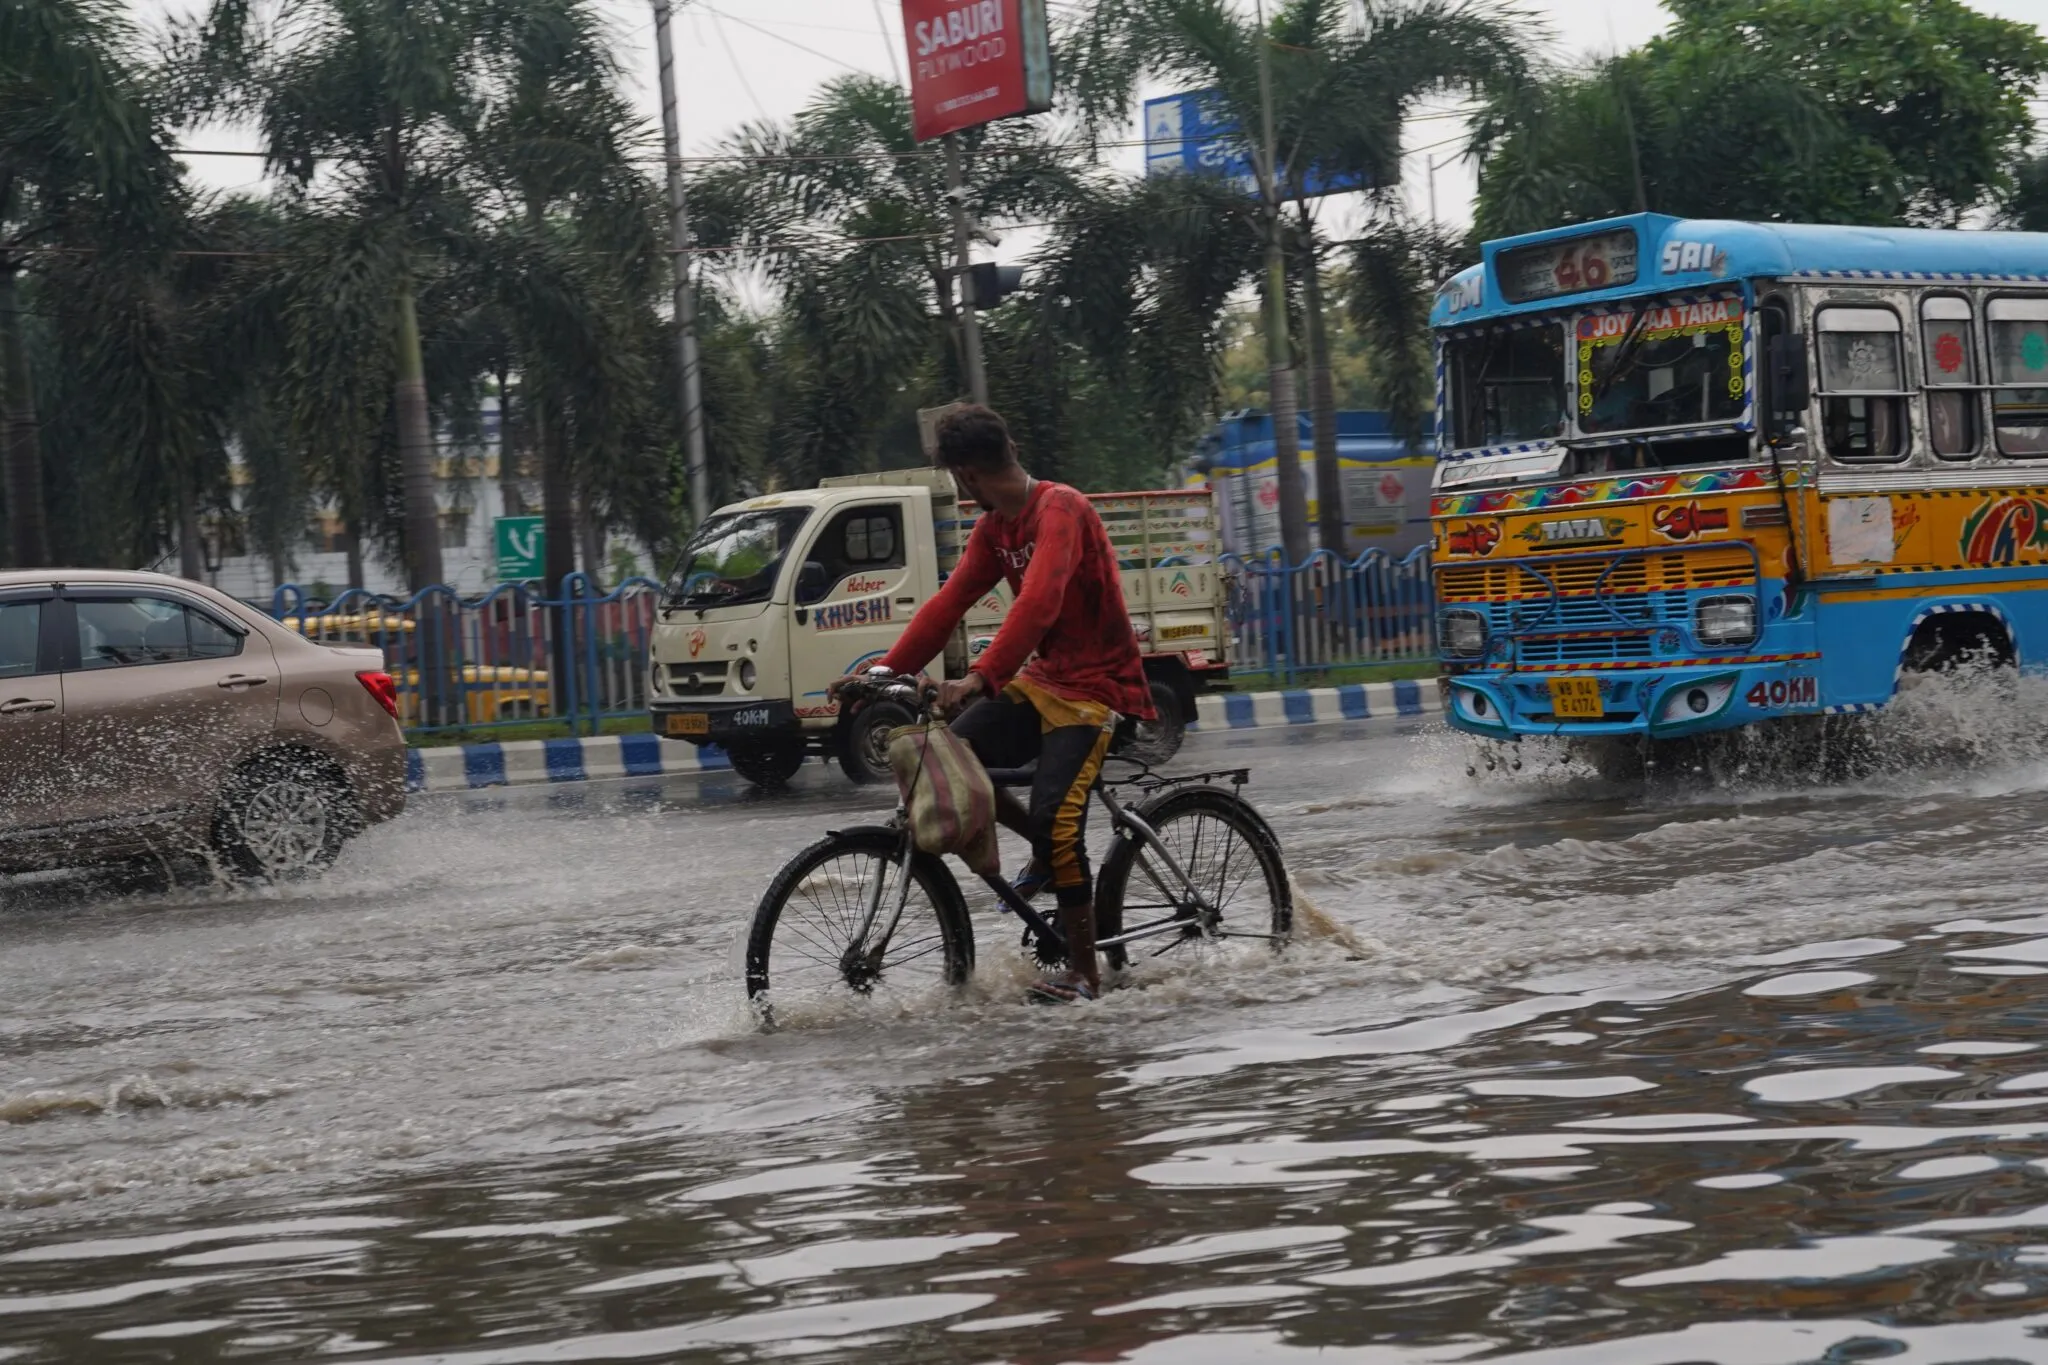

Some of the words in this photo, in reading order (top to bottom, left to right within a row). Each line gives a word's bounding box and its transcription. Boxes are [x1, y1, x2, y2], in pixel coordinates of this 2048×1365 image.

[915, 0, 1004, 55] SABURI
[917, 37, 1007, 81] PLYWOOD
[1553, 243, 1609, 289] 46
[1661, 241, 1716, 276] SAI
[1594, 314, 1629, 337] JOY
[1677, 302, 1728, 324] TARA
[1541, 519, 1604, 540] TATA
[847, 576, 886, 593] Helper
[814, 596, 891, 630] KHUSHI
[1745, 676, 1818, 708] 40KM
